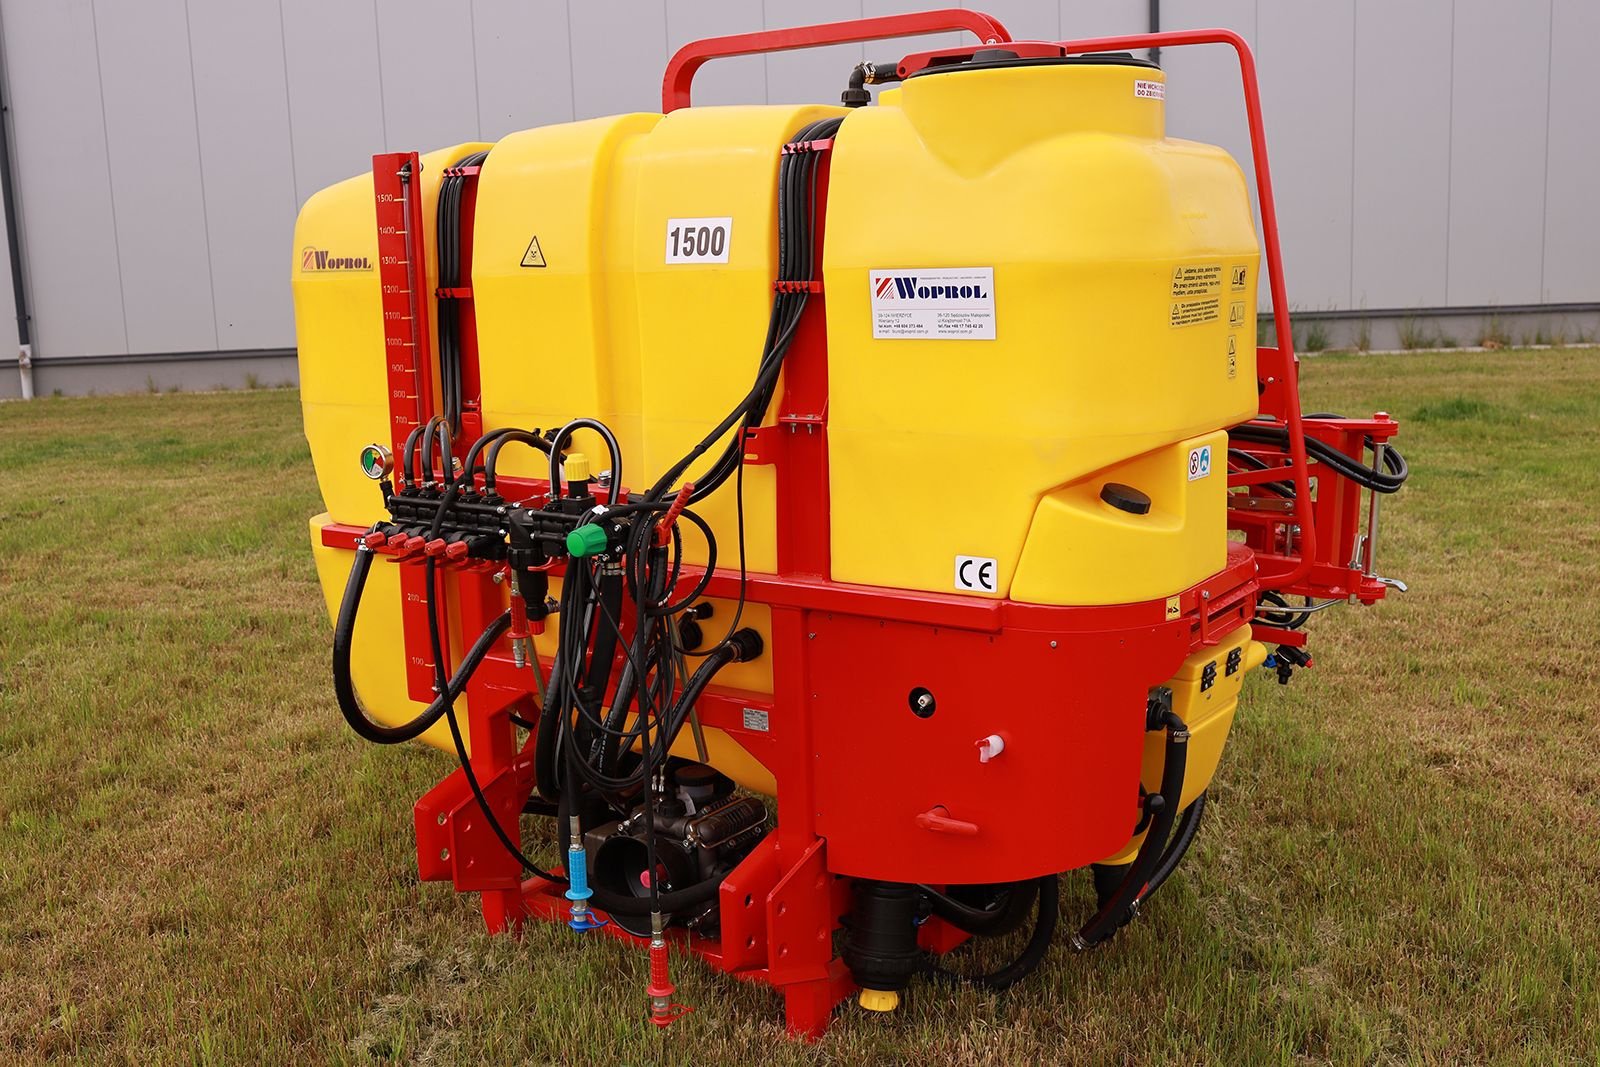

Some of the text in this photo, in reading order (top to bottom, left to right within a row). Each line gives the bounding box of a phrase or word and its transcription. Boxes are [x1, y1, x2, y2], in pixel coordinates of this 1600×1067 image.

[377, 194, 393, 202] 1500
[379, 226, 396, 234] 1400
[670, 226, 726, 257] 1500
[382, 256, 397, 265] 1300
[385, 312, 401, 320] 1100
[386, 338, 402, 346] 1000
[391, 364, 404, 372] 900
[393, 390, 406, 398] 800
[395, 416, 408, 424] 700
[959, 560, 992, 590] CE
[407, 593, 420, 601] 200
[412, 656, 424, 666] 100
